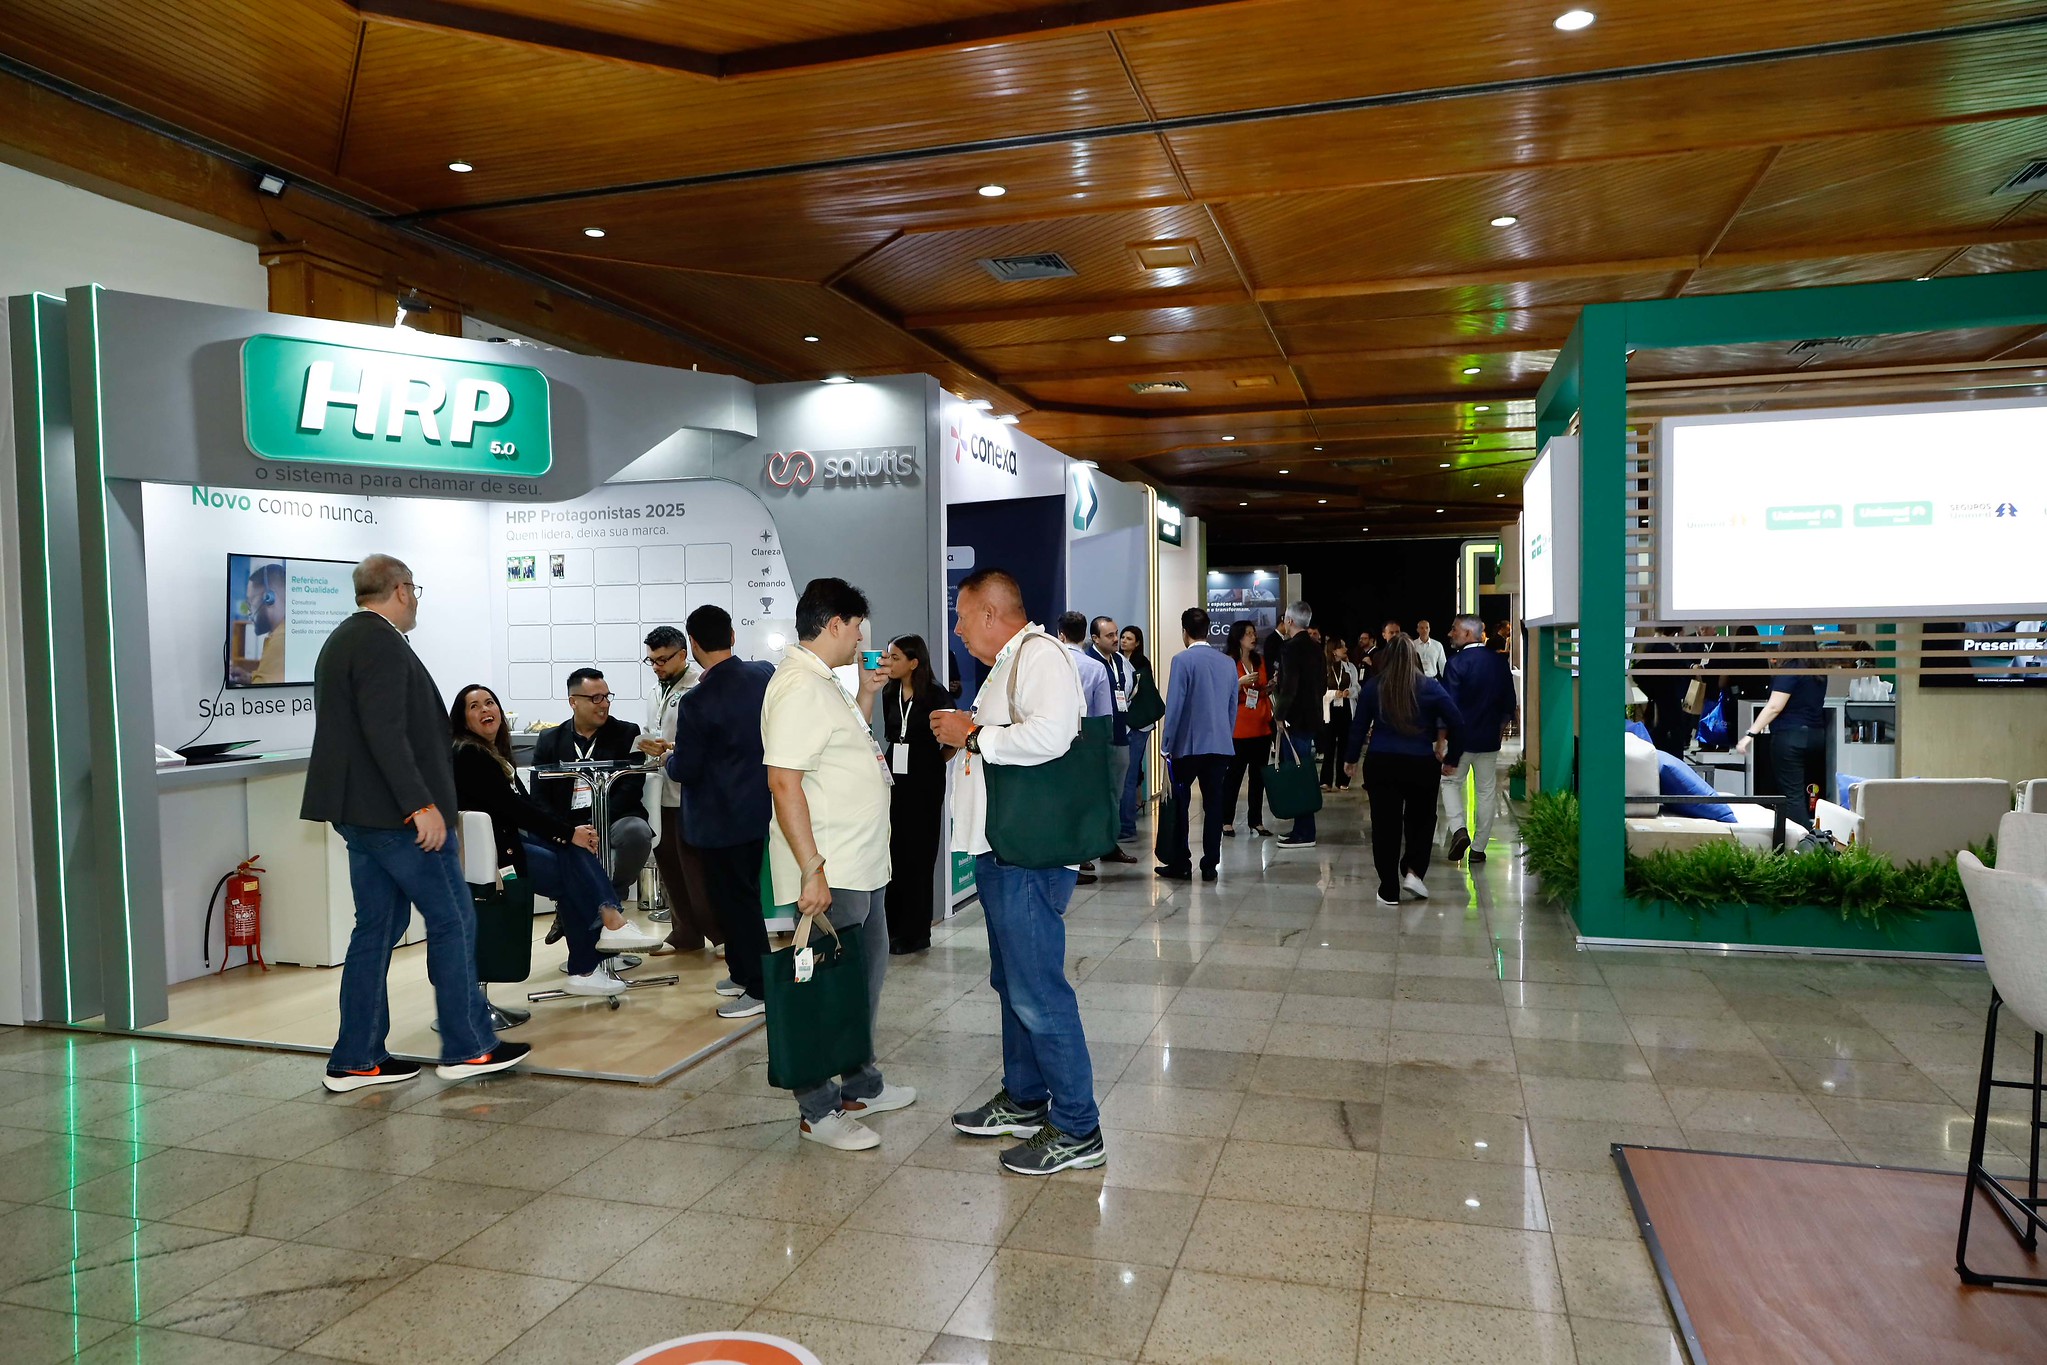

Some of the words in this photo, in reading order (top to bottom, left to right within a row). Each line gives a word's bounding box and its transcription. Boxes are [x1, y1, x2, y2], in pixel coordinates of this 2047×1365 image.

[300, 361, 511, 443] HRP
[489, 441, 516, 456] 5.0
[970, 433, 1018, 477] conexa
[824, 450, 913, 479] salutis
[255, 467, 268, 480] o
[275, 465, 353, 486] sistema
[360, 473, 402, 490] para
[408, 474, 475, 492] chamar
[481, 478, 503, 494] de
[508, 482, 542, 496] seu.
[191, 485, 251, 511] Novo
[258, 497, 313, 518] como
[319, 504, 378, 525] nunca.
[506, 511, 537, 524] HRP
[541, 506, 641, 525] Protagonistas
[645, 503, 686, 518] 2025
[1950, 503, 1992, 511] SEGUROS
[506, 530, 538, 541] Quem
[541, 529, 574, 540] lidera,
[577, 527, 606, 539] deixa
[609, 528, 629, 537] sua
[632, 526, 669, 537] marca.
[751, 548, 781, 556] Clareza
[304, 585, 339, 594] Qualidade
[747, 580, 786, 588] Comando
[1963, 639, 2044, 651] Presentes
[199, 698, 235, 718] Sua
[242, 697, 286, 715] base
